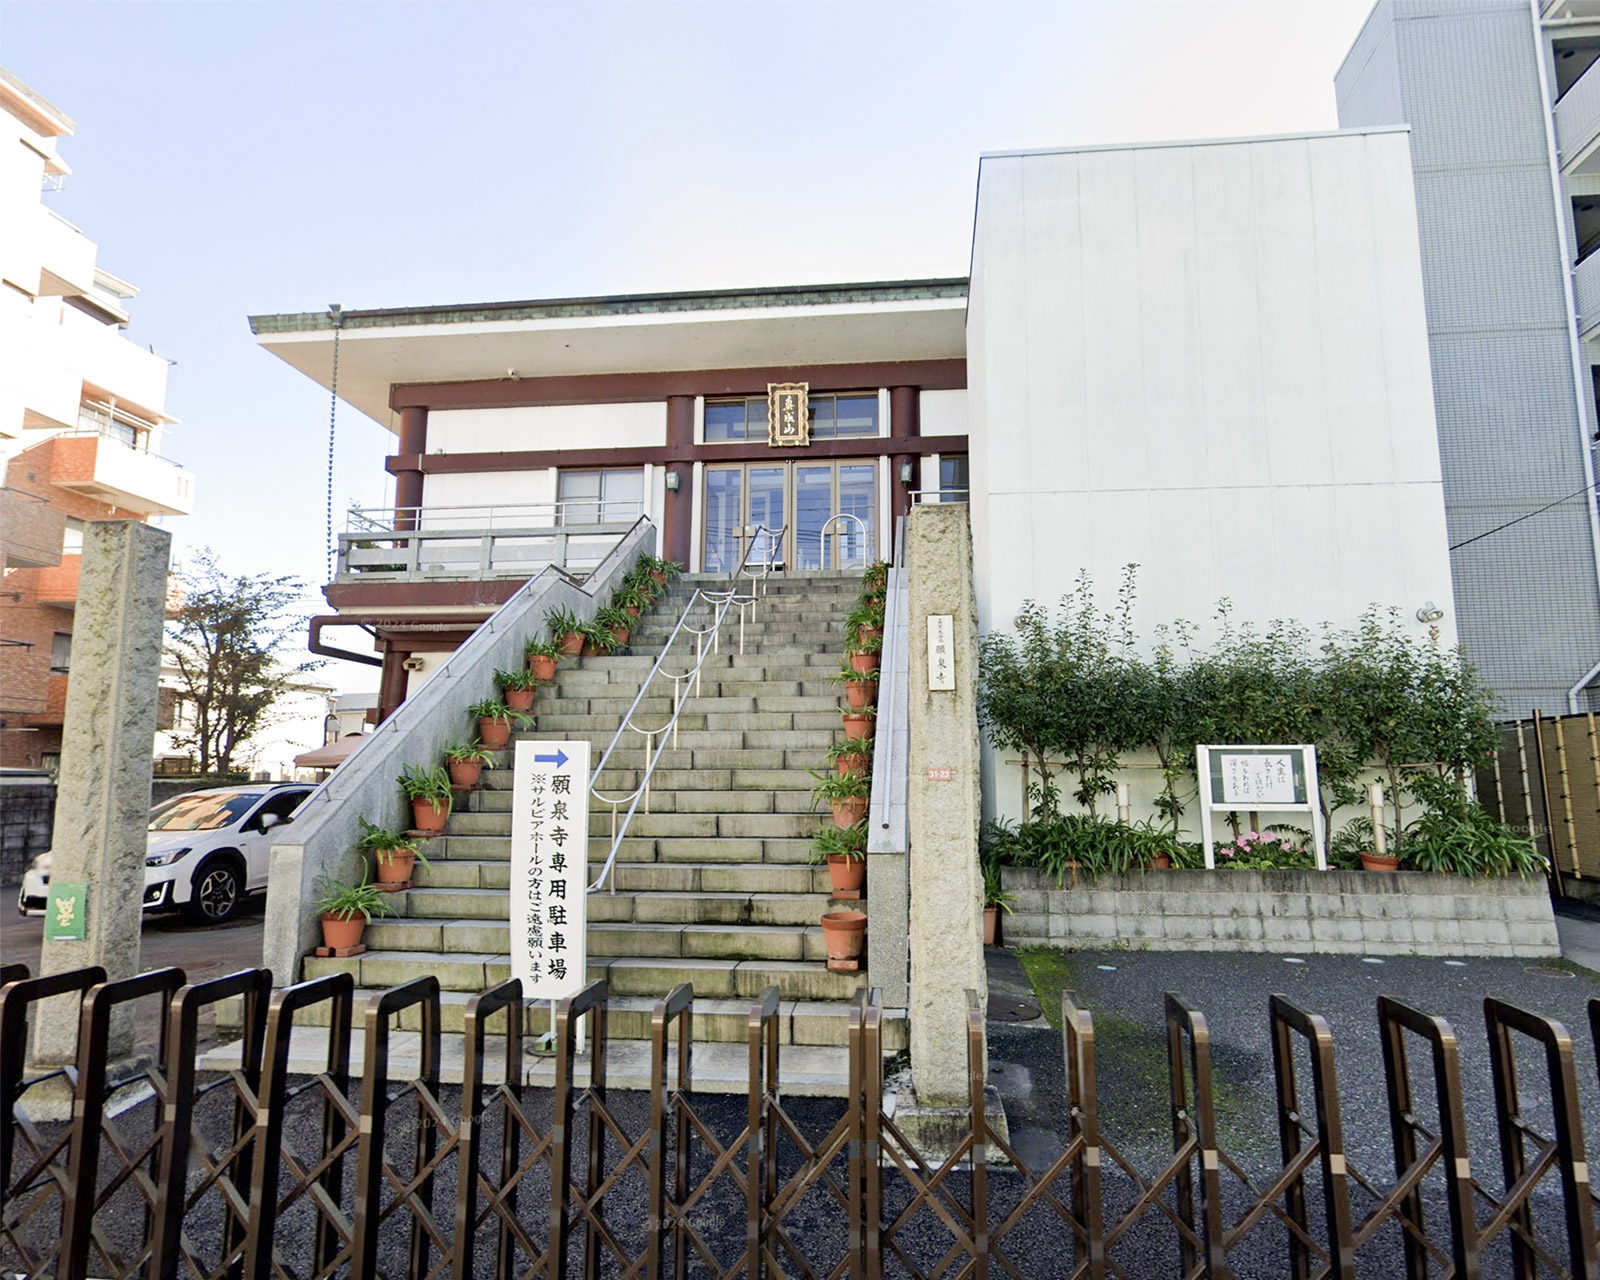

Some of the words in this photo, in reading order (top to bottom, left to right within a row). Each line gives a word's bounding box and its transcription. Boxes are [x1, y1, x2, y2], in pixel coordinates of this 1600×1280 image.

[935, 644, 947, 684] 願泉寺
[928, 769, 950, 778] 31-23
[1276, 758, 1286, 783] 人生は
[547, 774, 571, 980] 願泉寺専用駐車場
